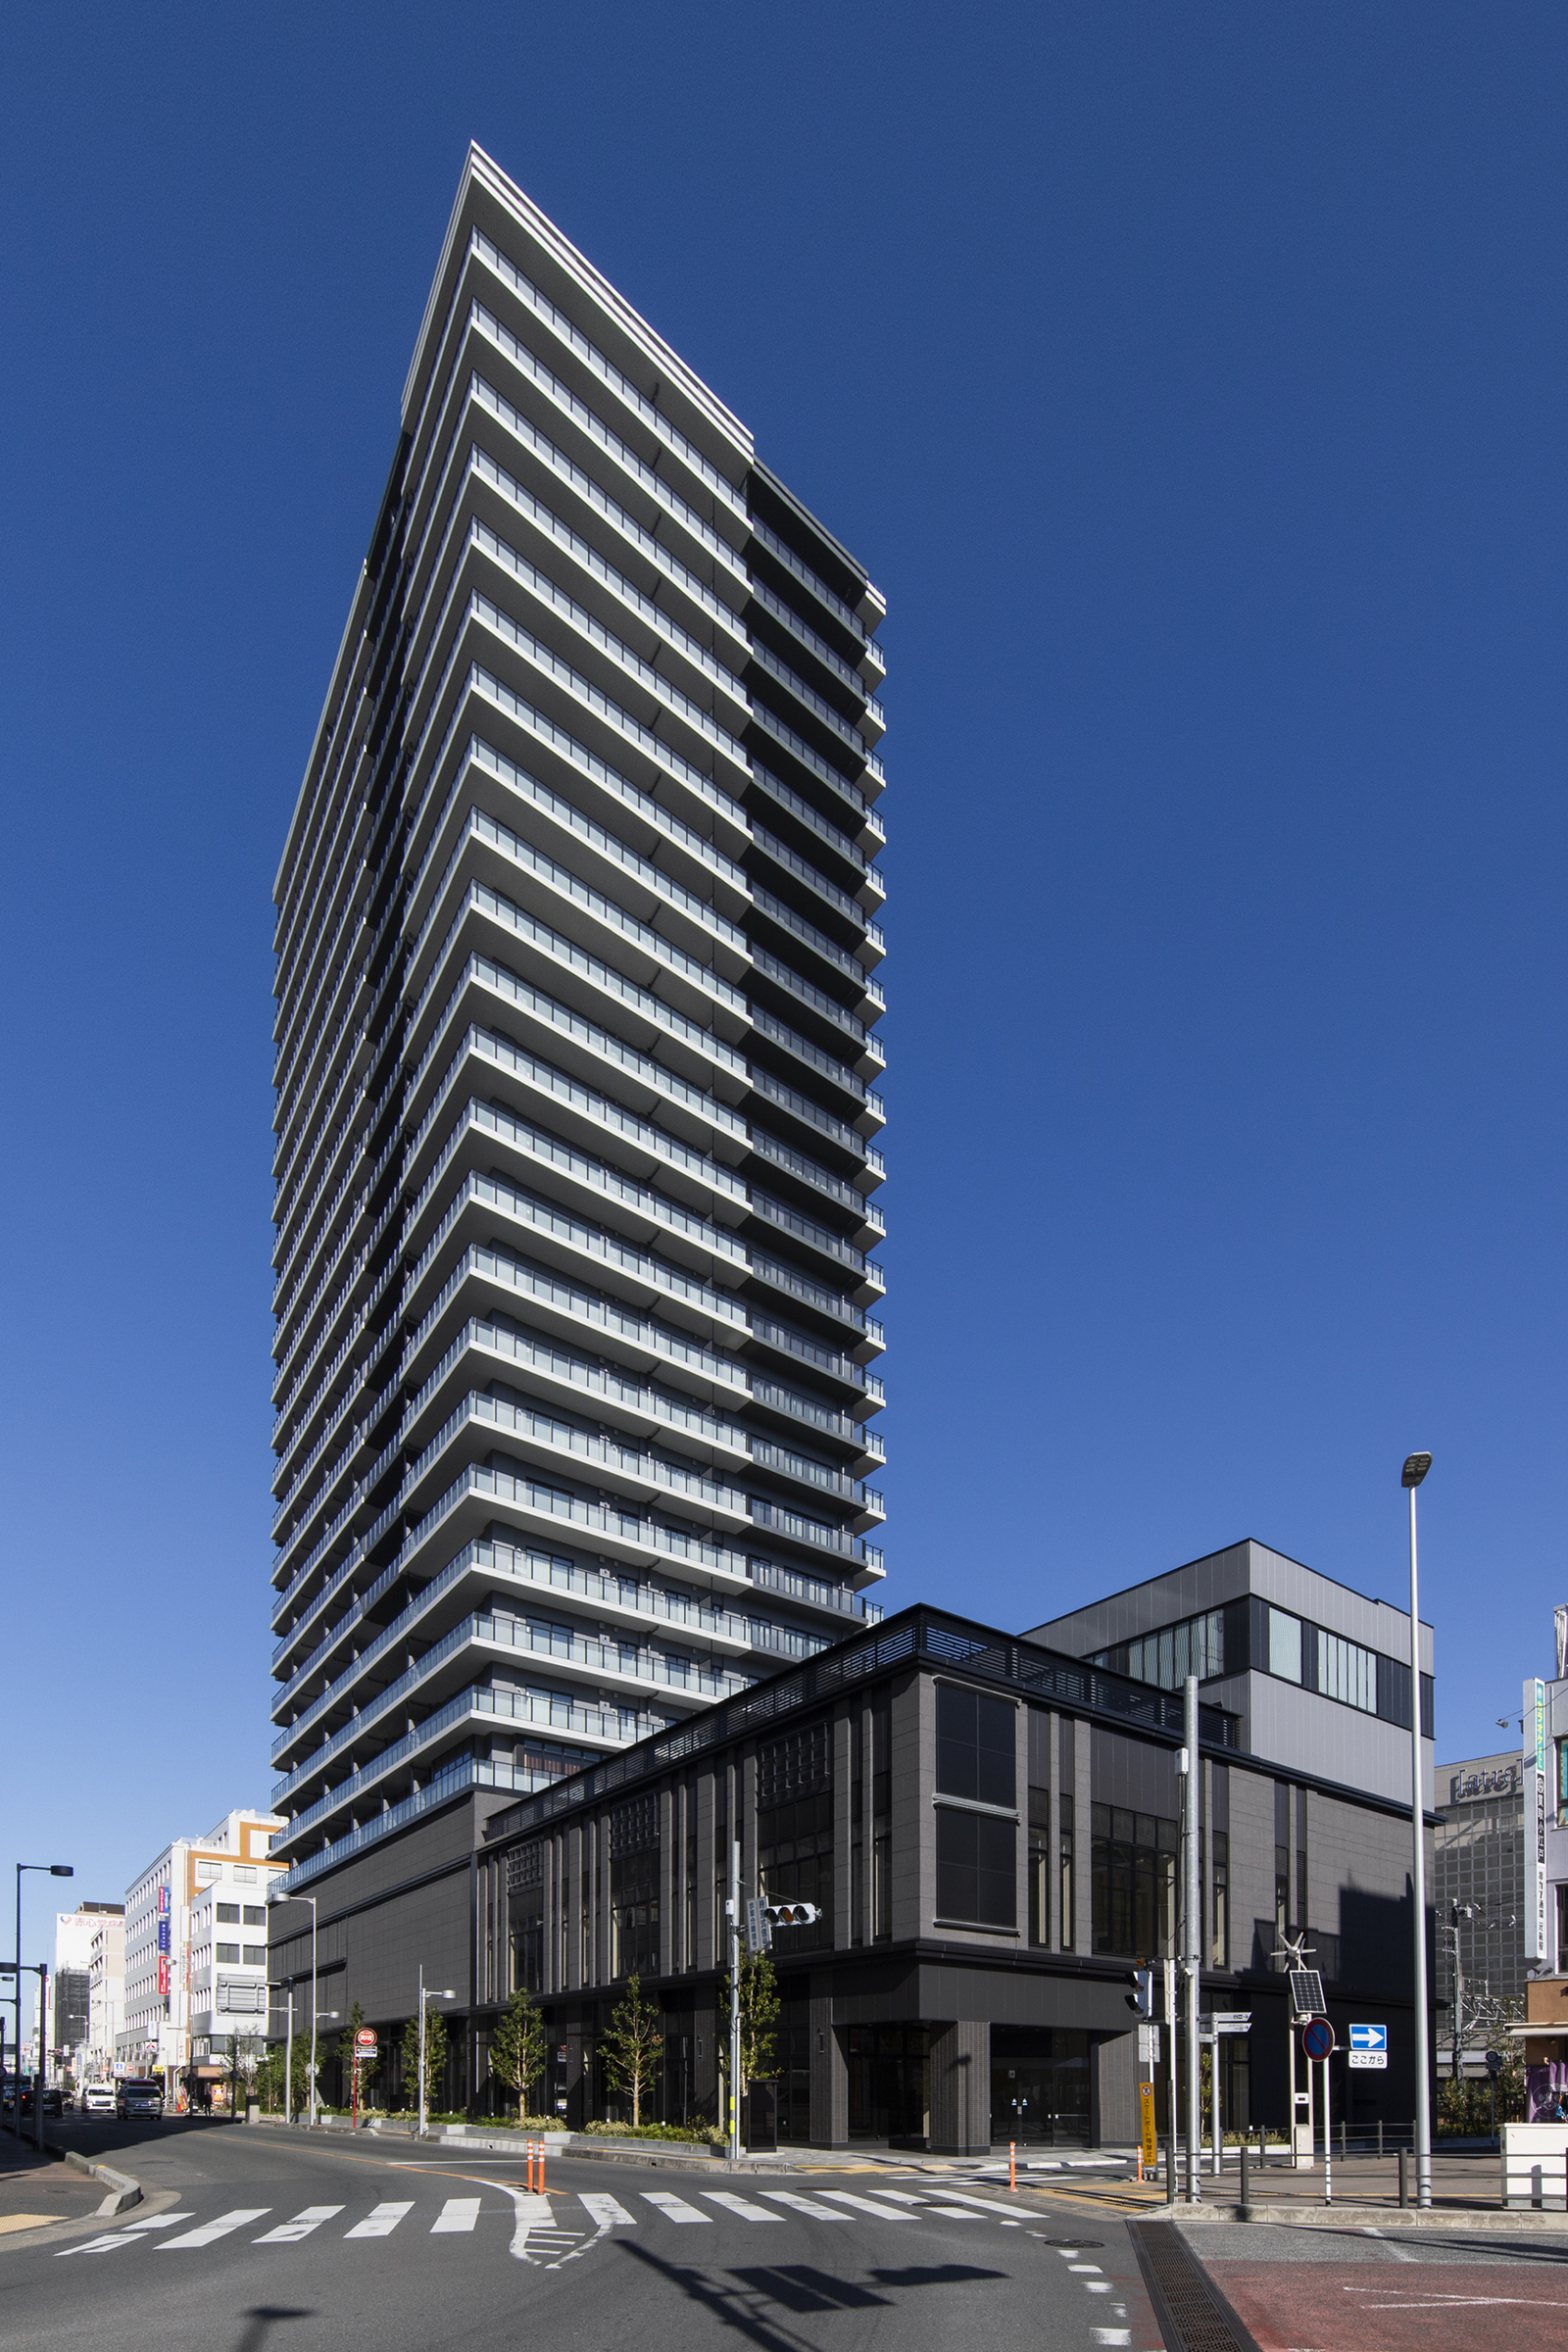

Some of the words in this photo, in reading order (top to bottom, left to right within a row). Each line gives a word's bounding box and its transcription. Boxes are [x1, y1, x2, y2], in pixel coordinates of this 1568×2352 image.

[1351, 2055, 1385, 2065] ここから
[1144, 2098, 1152, 2158] スケートボード等禁止
